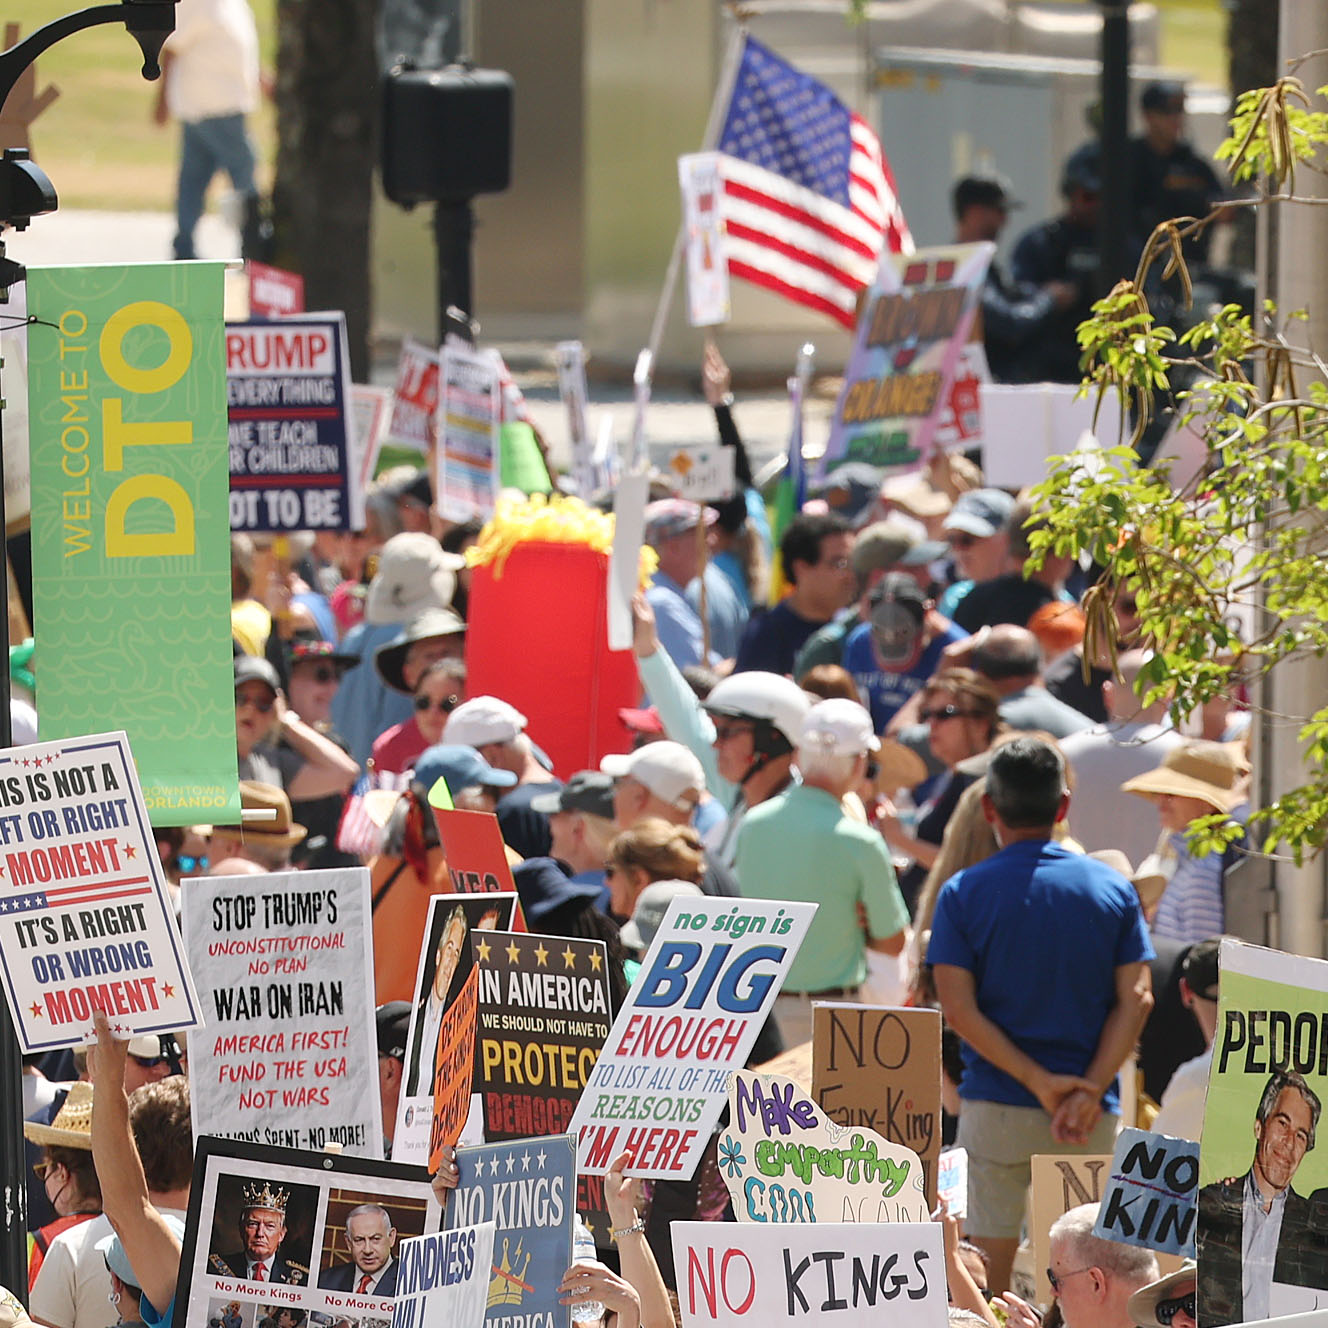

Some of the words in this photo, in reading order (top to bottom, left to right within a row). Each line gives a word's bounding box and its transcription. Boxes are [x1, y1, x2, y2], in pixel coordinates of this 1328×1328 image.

[60, 309, 87, 356] TO
[227, 378, 334, 405] EVERYTHING
[99, 300, 194, 558] DTO
[60, 372, 90, 558] WELCOME
[26, 773, 51, 802] IS
[52, 767, 102, 799] NOT
[100, 763, 119, 792] A
[28, 811, 59, 840] OR
[66, 799, 130, 834] RIGHT
[5, 839, 123, 887] MOMENT
[14, 918, 57, 949] IT'S
[62, 914, 80, 942] A
[78, 903, 147, 938] RIGHT
[213, 895, 256, 931] STOP
[262, 889, 337, 930] TRUMP'S
[674, 912, 707, 930] no
[712, 907, 765, 939] sign
[770, 910, 793, 934] is
[32, 953, 65, 984] OR
[65, 940, 152, 977] WRONG
[209, 932, 345, 957] UNCONSTITUTIONAL
[249, 960, 270, 976] NO
[275, 956, 307, 973] PLAN
[634, 941, 787, 1014] BIG
[43, 976, 159, 1025] MOMENT
[213, 986, 262, 1022] WAR
[268, 984, 293, 1019] ON
[299, 980, 343, 1016] IRAN
[479, 969, 501, 1004] IN
[508, 972, 606, 1014] AMERICA
[214, 1033, 284, 1056] AMERICA
[291, 1026, 349, 1050] FIRST!
[482, 1014, 501, 1029] WE
[502, 1016, 544, 1032] SHOULD
[547, 1018, 566, 1034] NOT
[569, 1022, 594, 1037] HAVE
[595, 1024, 607, 1039] TO
[615, 1015, 747, 1061] ENOUGH
[219, 1061, 266, 1083] FUND
[274, 1060, 306, 1080] THE
[315, 1055, 346, 1078] USA
[594, 1064, 615, 1086] TO
[615, 1067, 647, 1088] LIST
[647, 1067, 676, 1089] ALL
[679, 1067, 703, 1090] OF
[239, 1088, 277, 1110] NOT
[283, 1087, 330, 1108] WARS
[590, 1095, 706, 1122] REASONS
[579, 1125, 622, 1168] I'M
[625, 1127, 700, 1171] HERE
[688, 1246, 755, 1318] NO
[783, 1248, 930, 1316] KINGS
